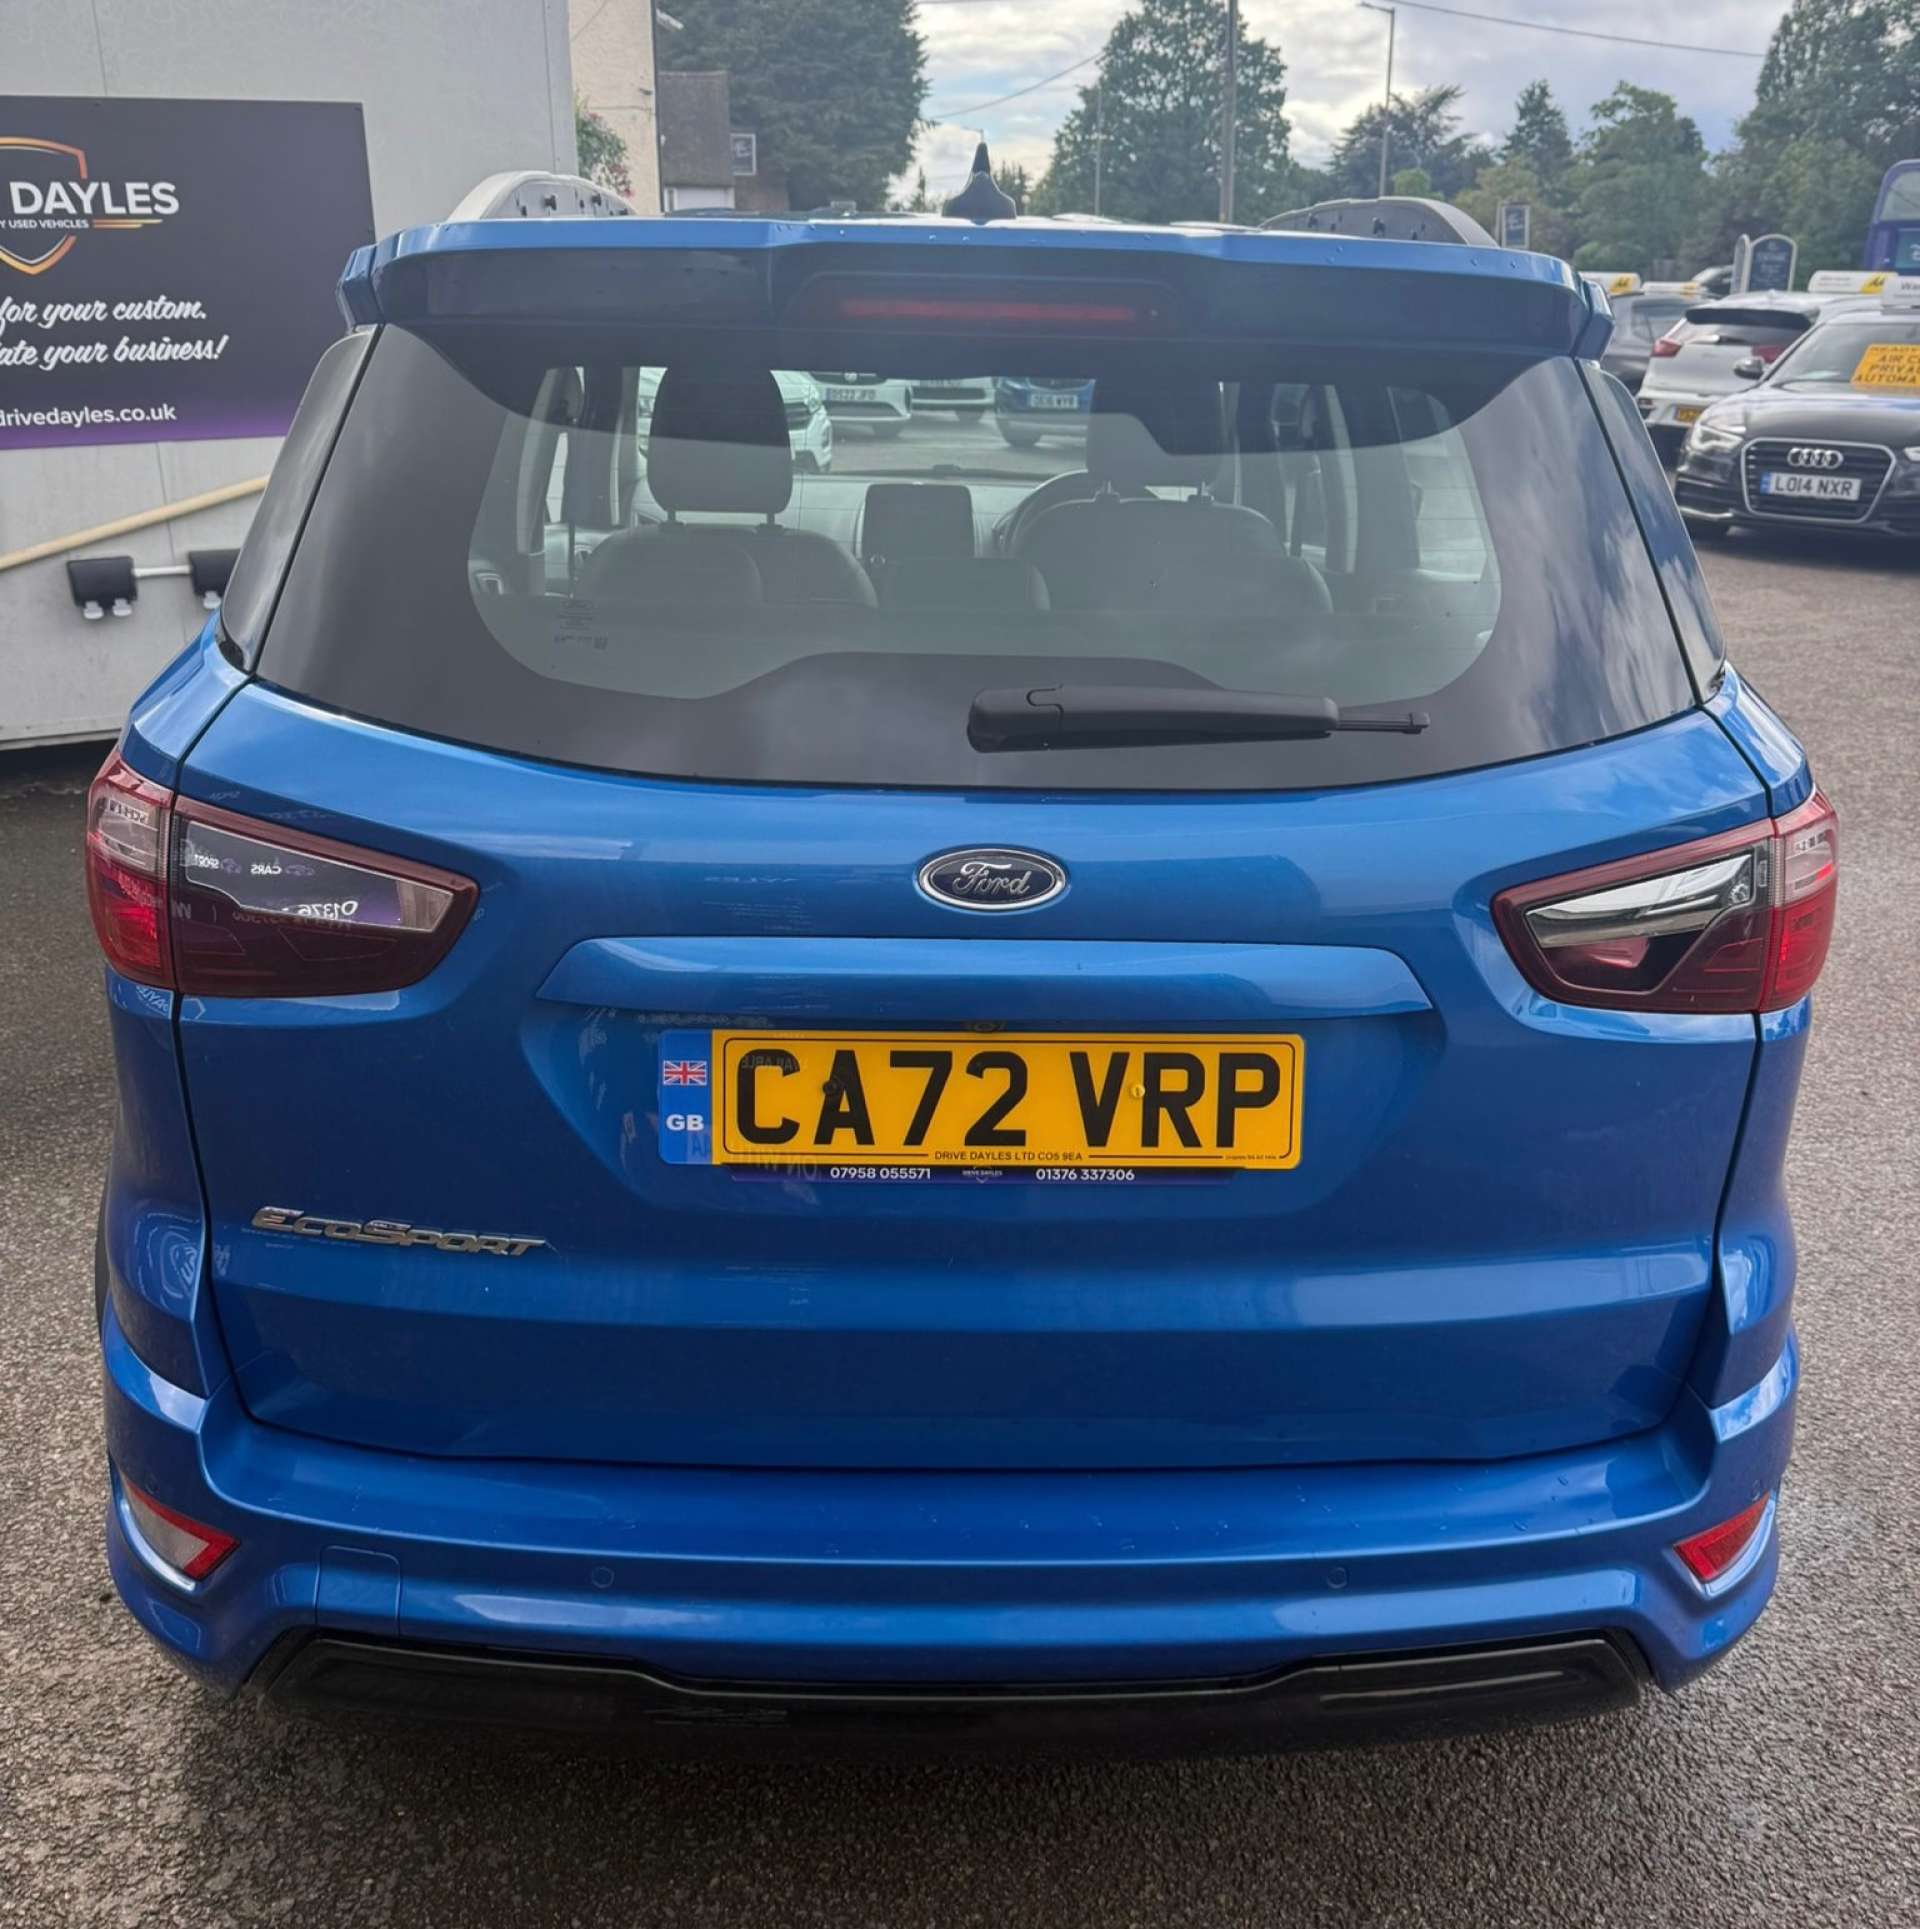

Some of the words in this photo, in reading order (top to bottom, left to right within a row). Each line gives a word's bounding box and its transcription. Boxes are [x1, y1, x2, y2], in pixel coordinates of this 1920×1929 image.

[9, 181, 180, 215] DAYLES
[8, 219, 38, 229] USED
[39, 219, 90, 229] VEHICLES
[37, 299, 108, 329] your
[112, 294, 207, 320] custom.
[0, 339, 38, 366] ate
[38, 342, 109, 371] your
[113, 334, 230, 362] business!
[1907, 354, 1920, 364] C
[1817, 479, 1853, 496] NXR
[951, 861, 1033, 896] Ford
[737, 1048, 1028, 1147] CA72
[1069, 1050, 1281, 1149] VRP
[665, 1113, 705, 1132] GB
[934, 1150, 967, 1161] DRIVE
[969, 1151, 1012, 1162] DAYLES
[1014, 1152, 1036, 1162] LTD
[830, 1166, 876, 1180] 07958
[879, 1167, 931, 1180] 055571
[1035, 1168, 1078, 1181] 01376
[1080, 1168, 1136, 1182] 337306
